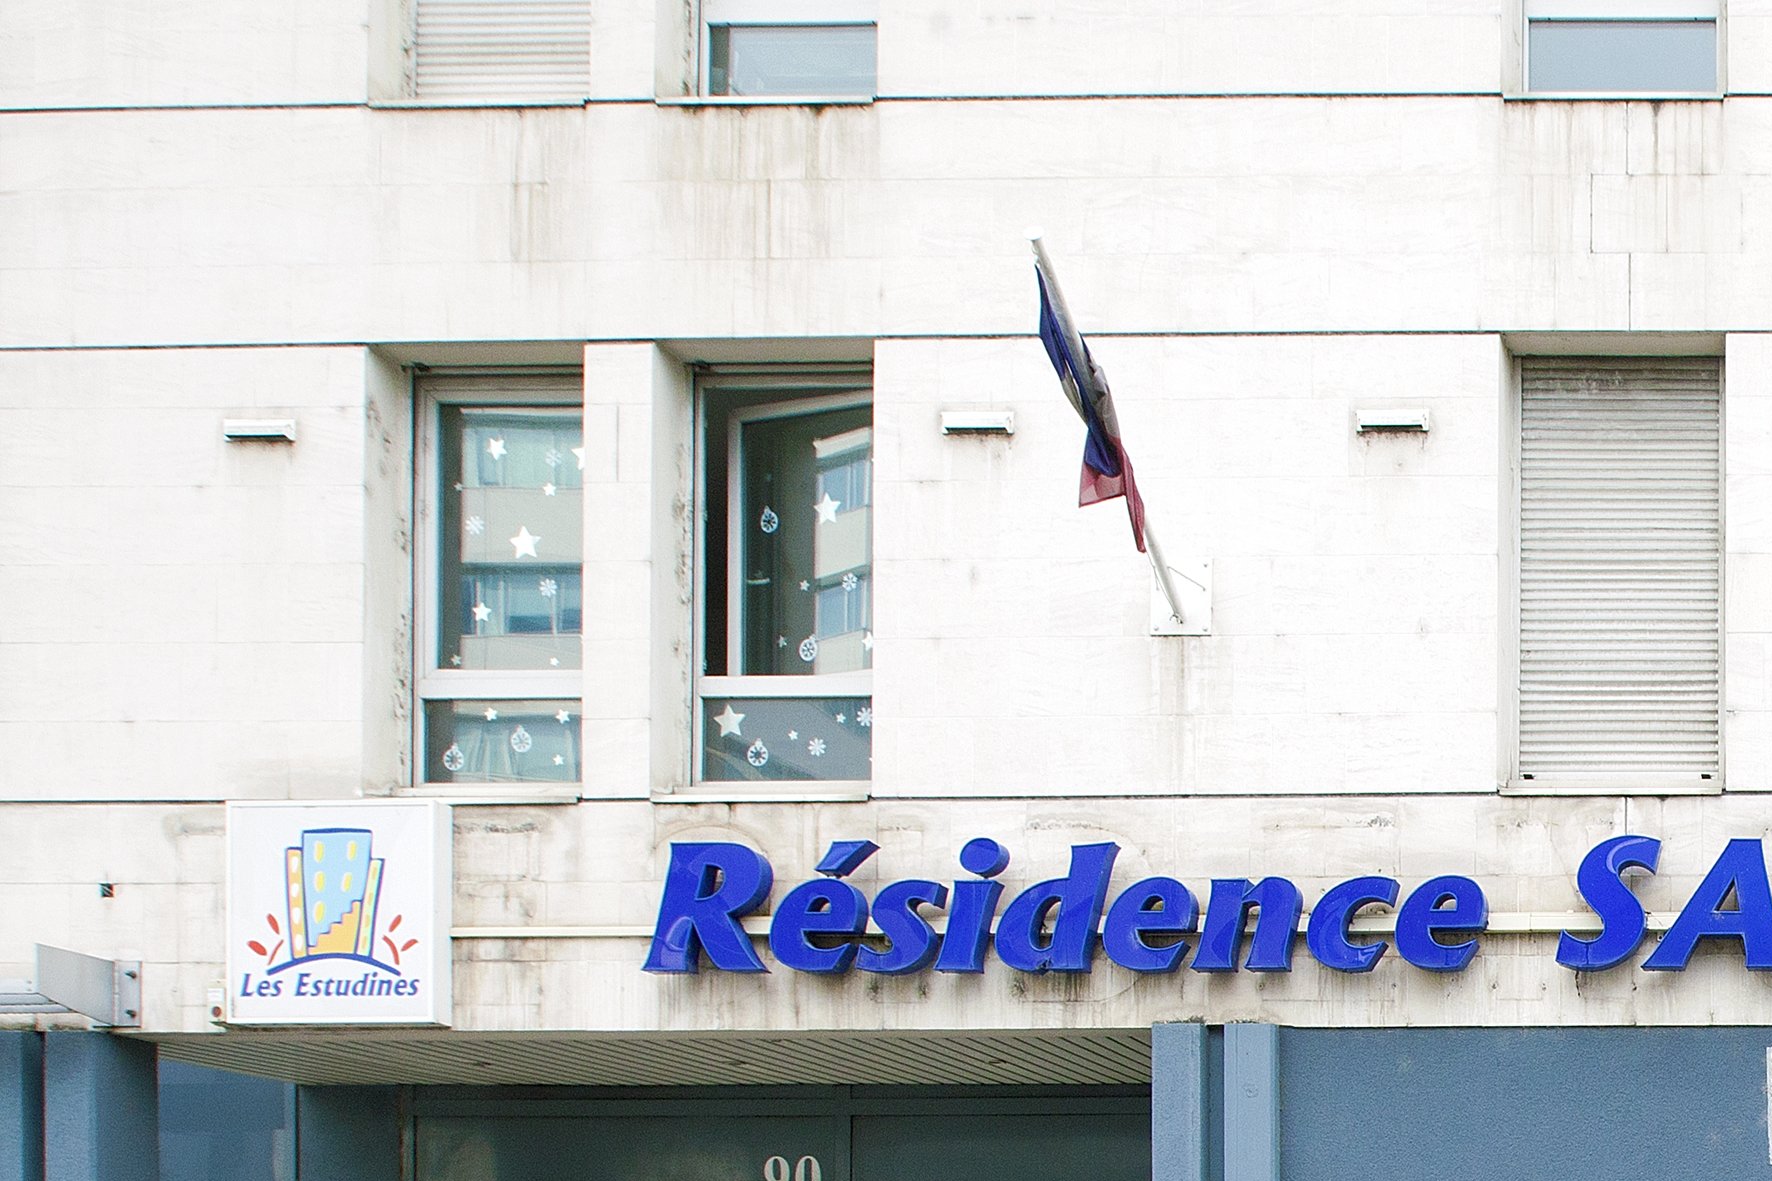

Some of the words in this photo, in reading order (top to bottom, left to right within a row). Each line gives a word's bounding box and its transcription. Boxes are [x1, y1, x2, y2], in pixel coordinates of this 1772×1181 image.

[641, 838, 1489, 974] Résidence
[240, 973, 283, 998] Les
[295, 971, 420, 998] Estudines
